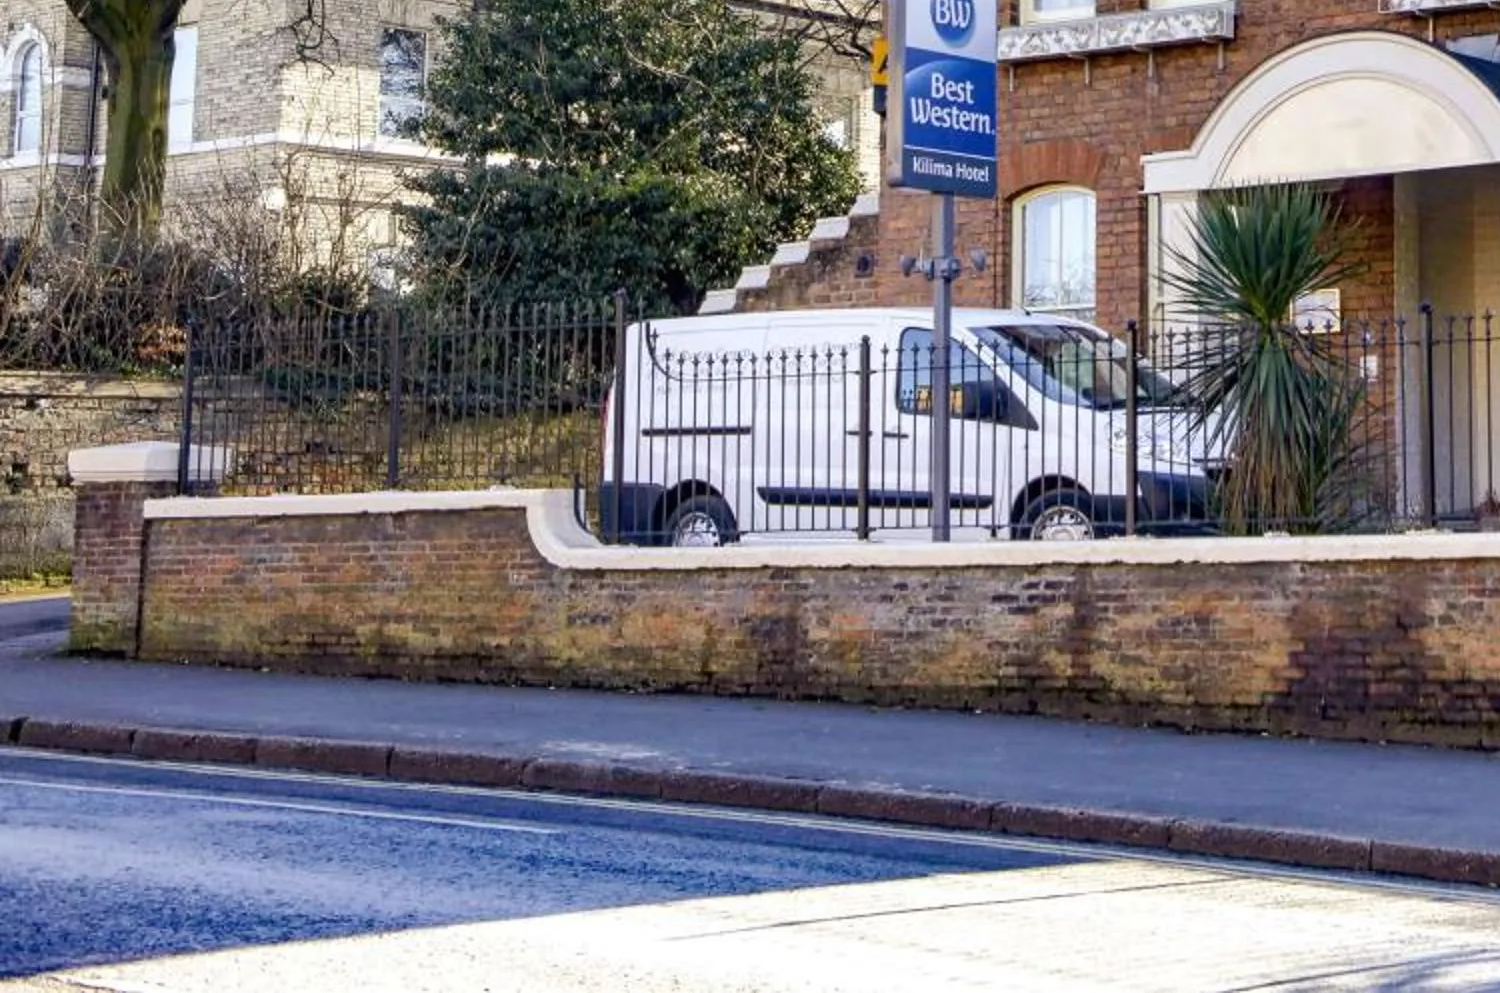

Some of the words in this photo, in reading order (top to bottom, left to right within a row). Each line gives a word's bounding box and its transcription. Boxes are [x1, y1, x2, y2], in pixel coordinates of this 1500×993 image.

[931, 72, 974, 104] Best
[913, 155, 953, 178] Kilima
[955, 162, 990, 182] Hotel
